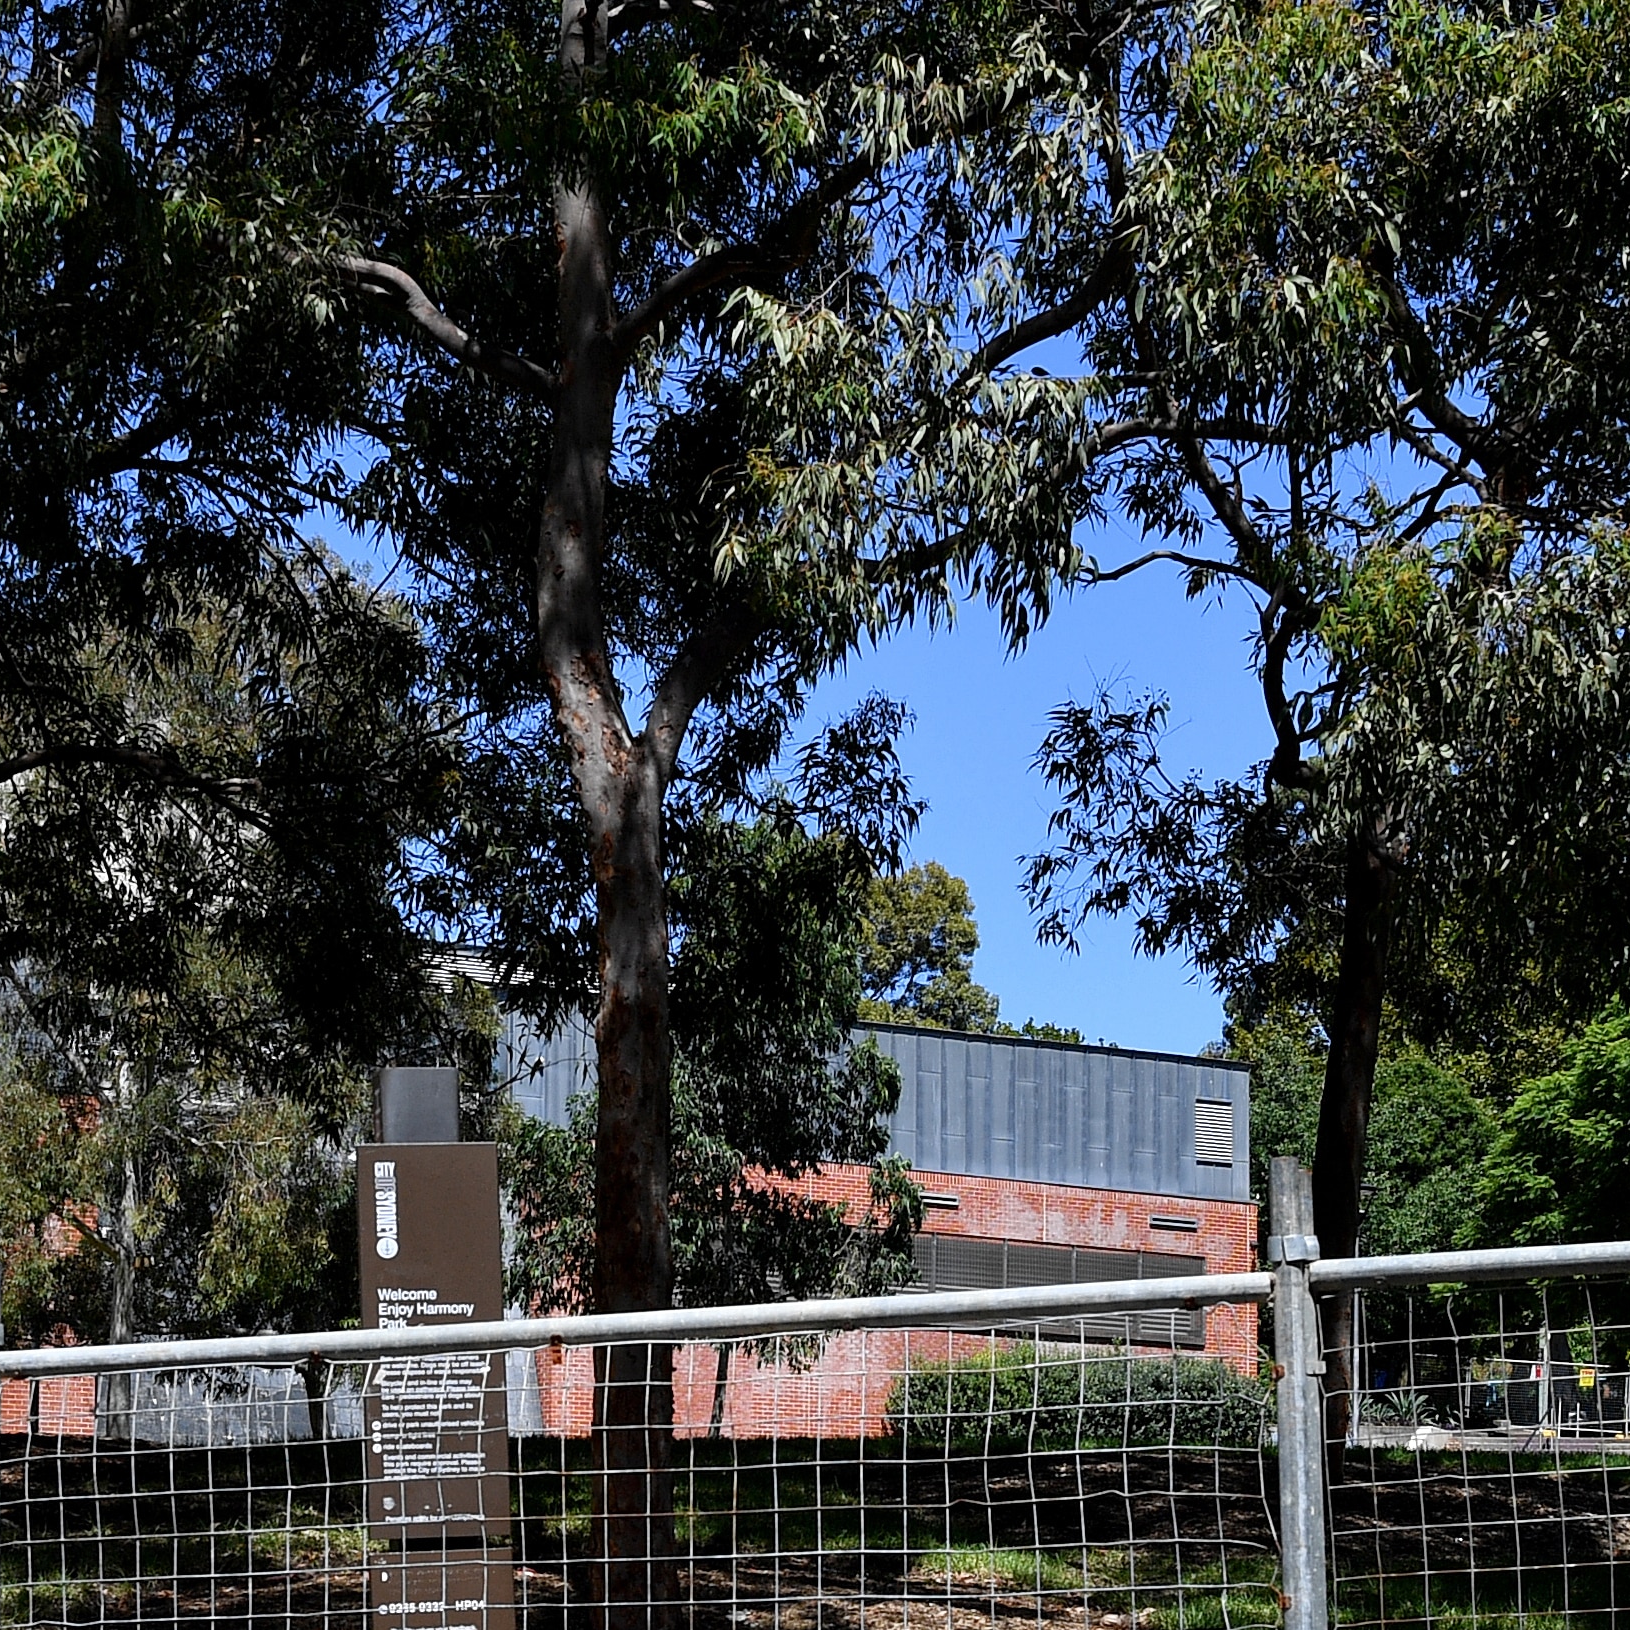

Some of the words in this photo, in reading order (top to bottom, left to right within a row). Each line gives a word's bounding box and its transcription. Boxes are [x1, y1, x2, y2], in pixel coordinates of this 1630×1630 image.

[374, 1162, 395, 1177] CITY
[375, 1191, 398, 1239] SYDNEY
[377, 1288, 438, 1301] Welcome
[378, 1303, 414, 1318] Enjoy
[416, 1301, 475, 1317] Harmony
